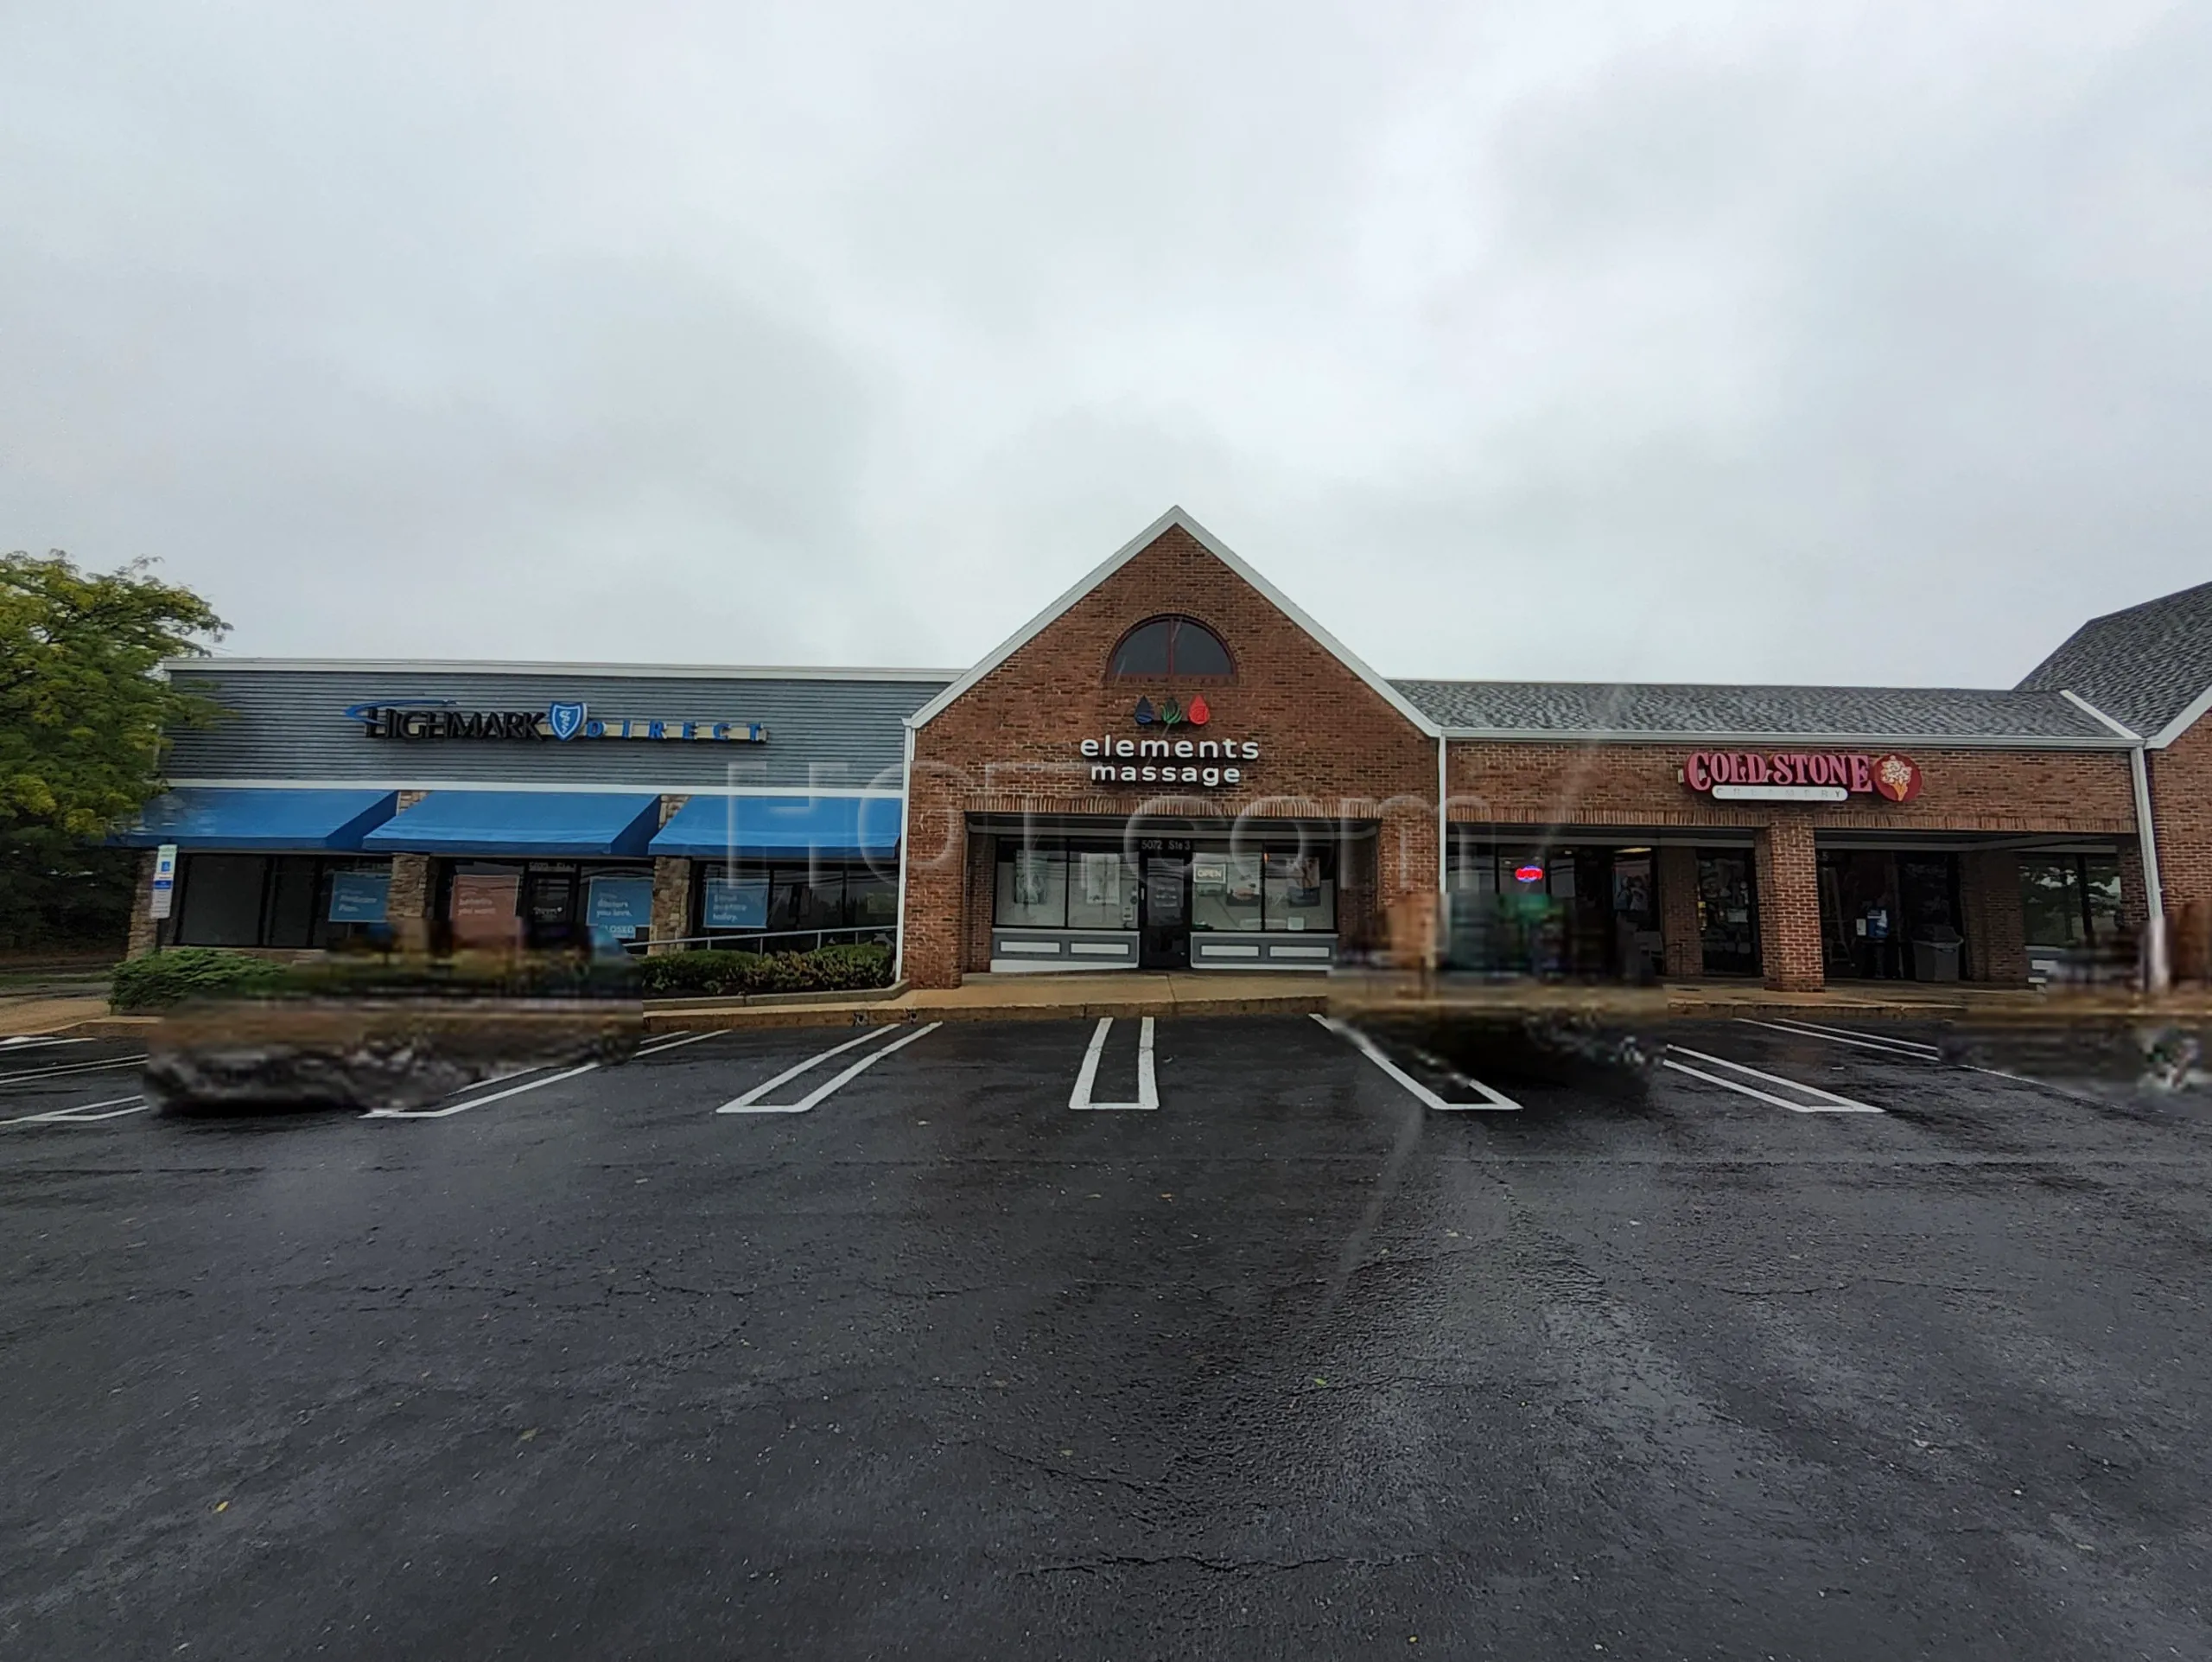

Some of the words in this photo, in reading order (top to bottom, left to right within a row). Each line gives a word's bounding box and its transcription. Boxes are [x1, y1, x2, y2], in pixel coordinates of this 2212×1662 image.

[365, 706, 547, 742] HIGHMARK
[588, 720, 765, 743] DIRECT
[1080, 735, 1259, 759] elements
[1091, 764, 1241, 786] massage
[1688, 752, 1770, 791] COLD
[1772, 754, 1873, 792] STONE
[1141, 839, 1163, 850] 5072
[1167, 839, 1183, 850] Ste
[1185, 840, 1191, 850] 3
[1197, 868, 1222, 879] OPEN
